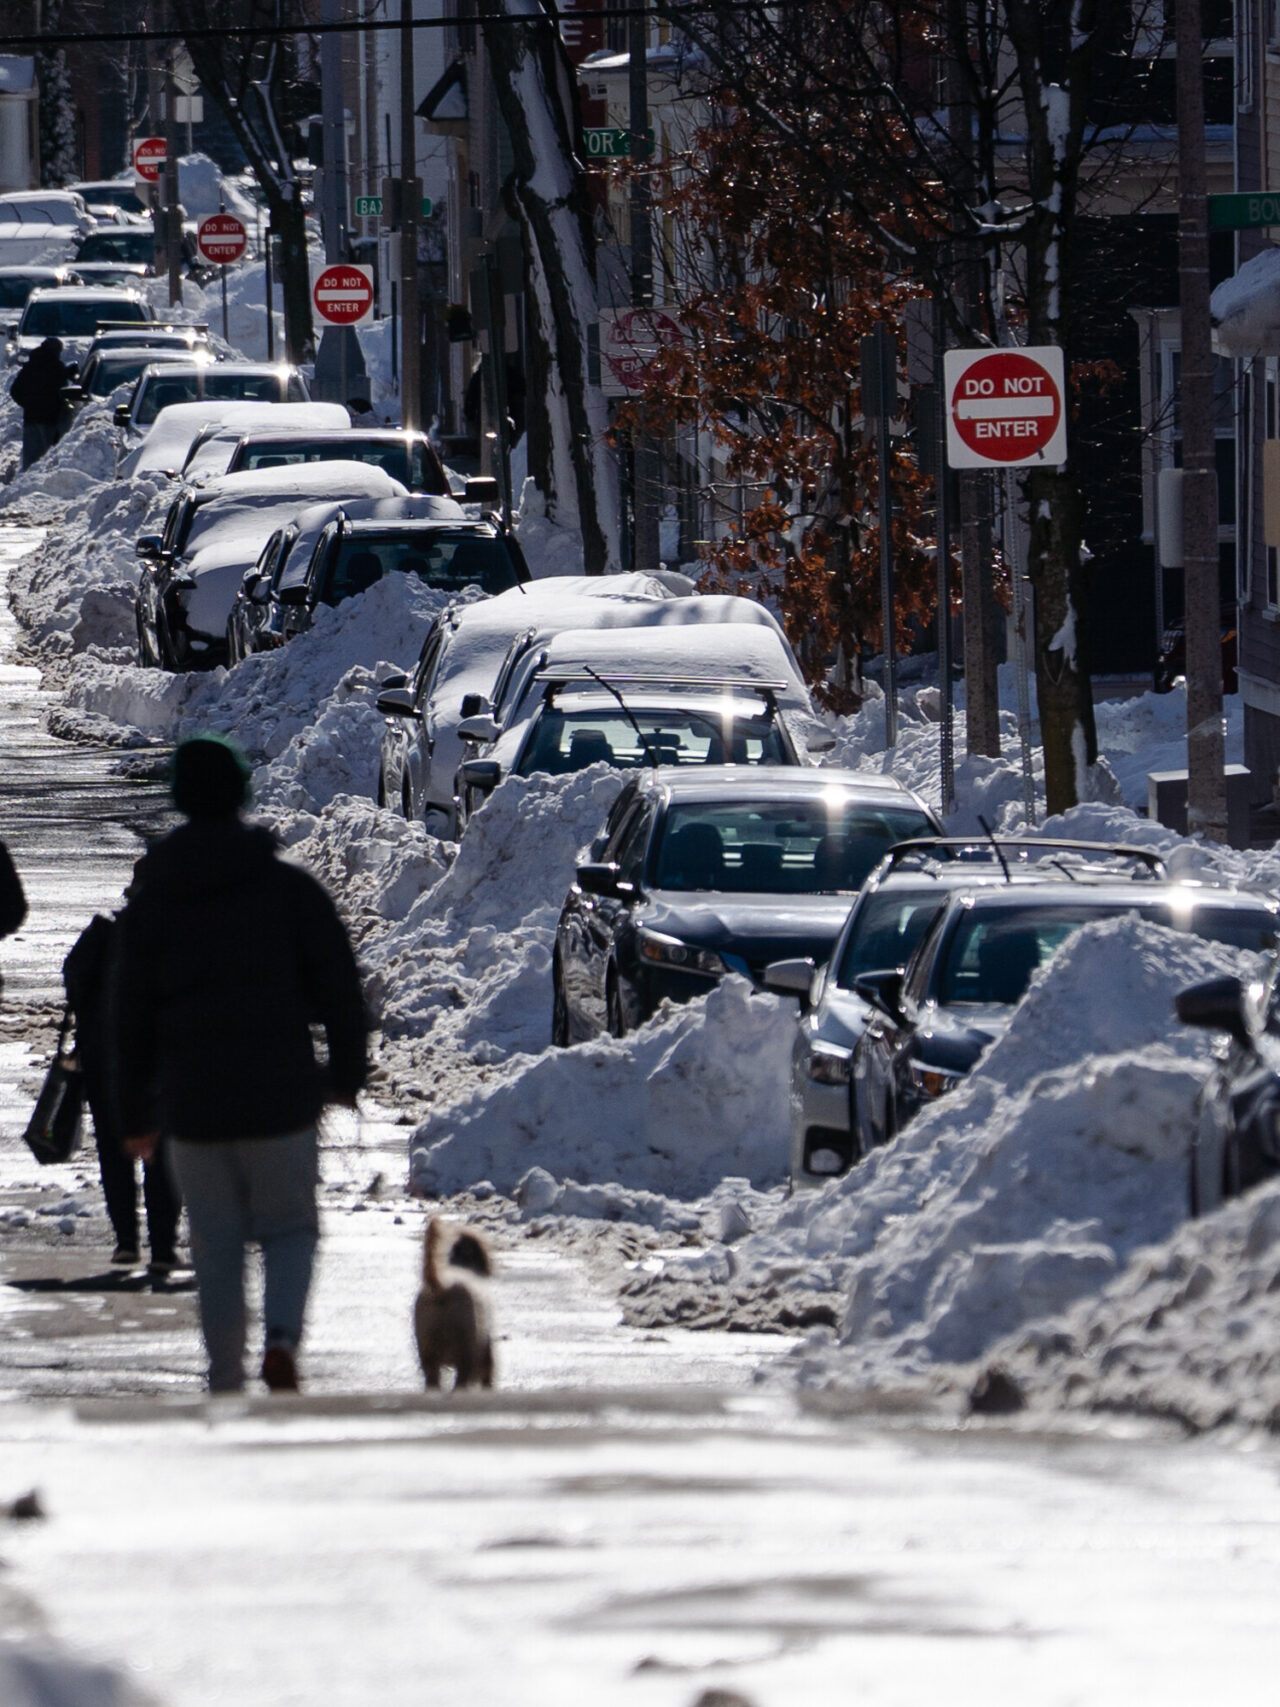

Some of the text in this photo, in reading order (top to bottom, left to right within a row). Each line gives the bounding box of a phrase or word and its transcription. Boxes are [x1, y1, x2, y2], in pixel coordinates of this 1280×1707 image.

[583, 132, 614, 153] OR
[155, 147, 166, 155] NO
[205, 223, 239, 232] DO NOT
[209, 246, 236, 255] ENTER
[324, 278, 362, 288] DO NOT
[327, 303, 360, 313] ENTER
[965, 377, 1045, 396] DO NOT
[976, 420, 1039, 439] ENTER
